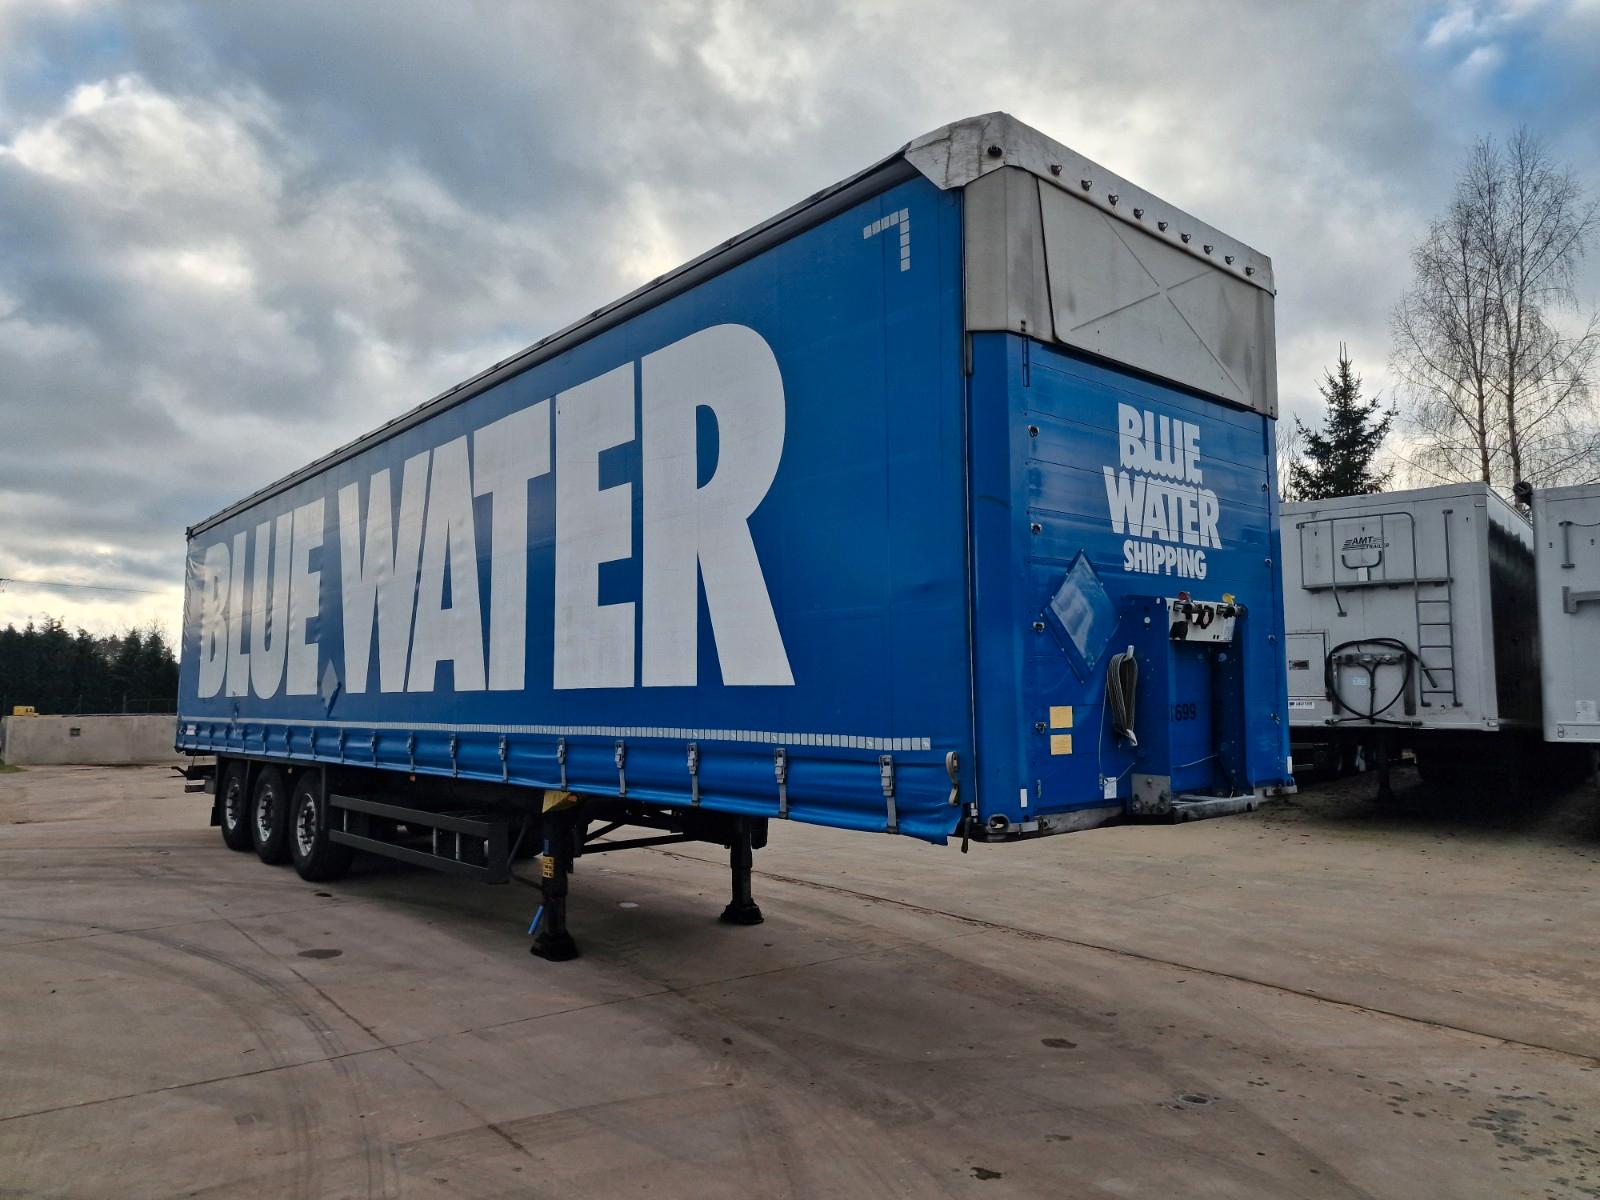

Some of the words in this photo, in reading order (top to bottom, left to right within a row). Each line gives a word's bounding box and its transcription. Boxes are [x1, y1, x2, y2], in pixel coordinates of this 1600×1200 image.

[1118, 402, 1203, 485] BLUE
[198, 497, 325, 700] BLUE
[338, 323, 796, 693] WATER
[1103, 465, 1222, 550] WATER
[1351, 536, 1374, 545] AMT
[1123, 539, 1207, 580] SHIPPING
